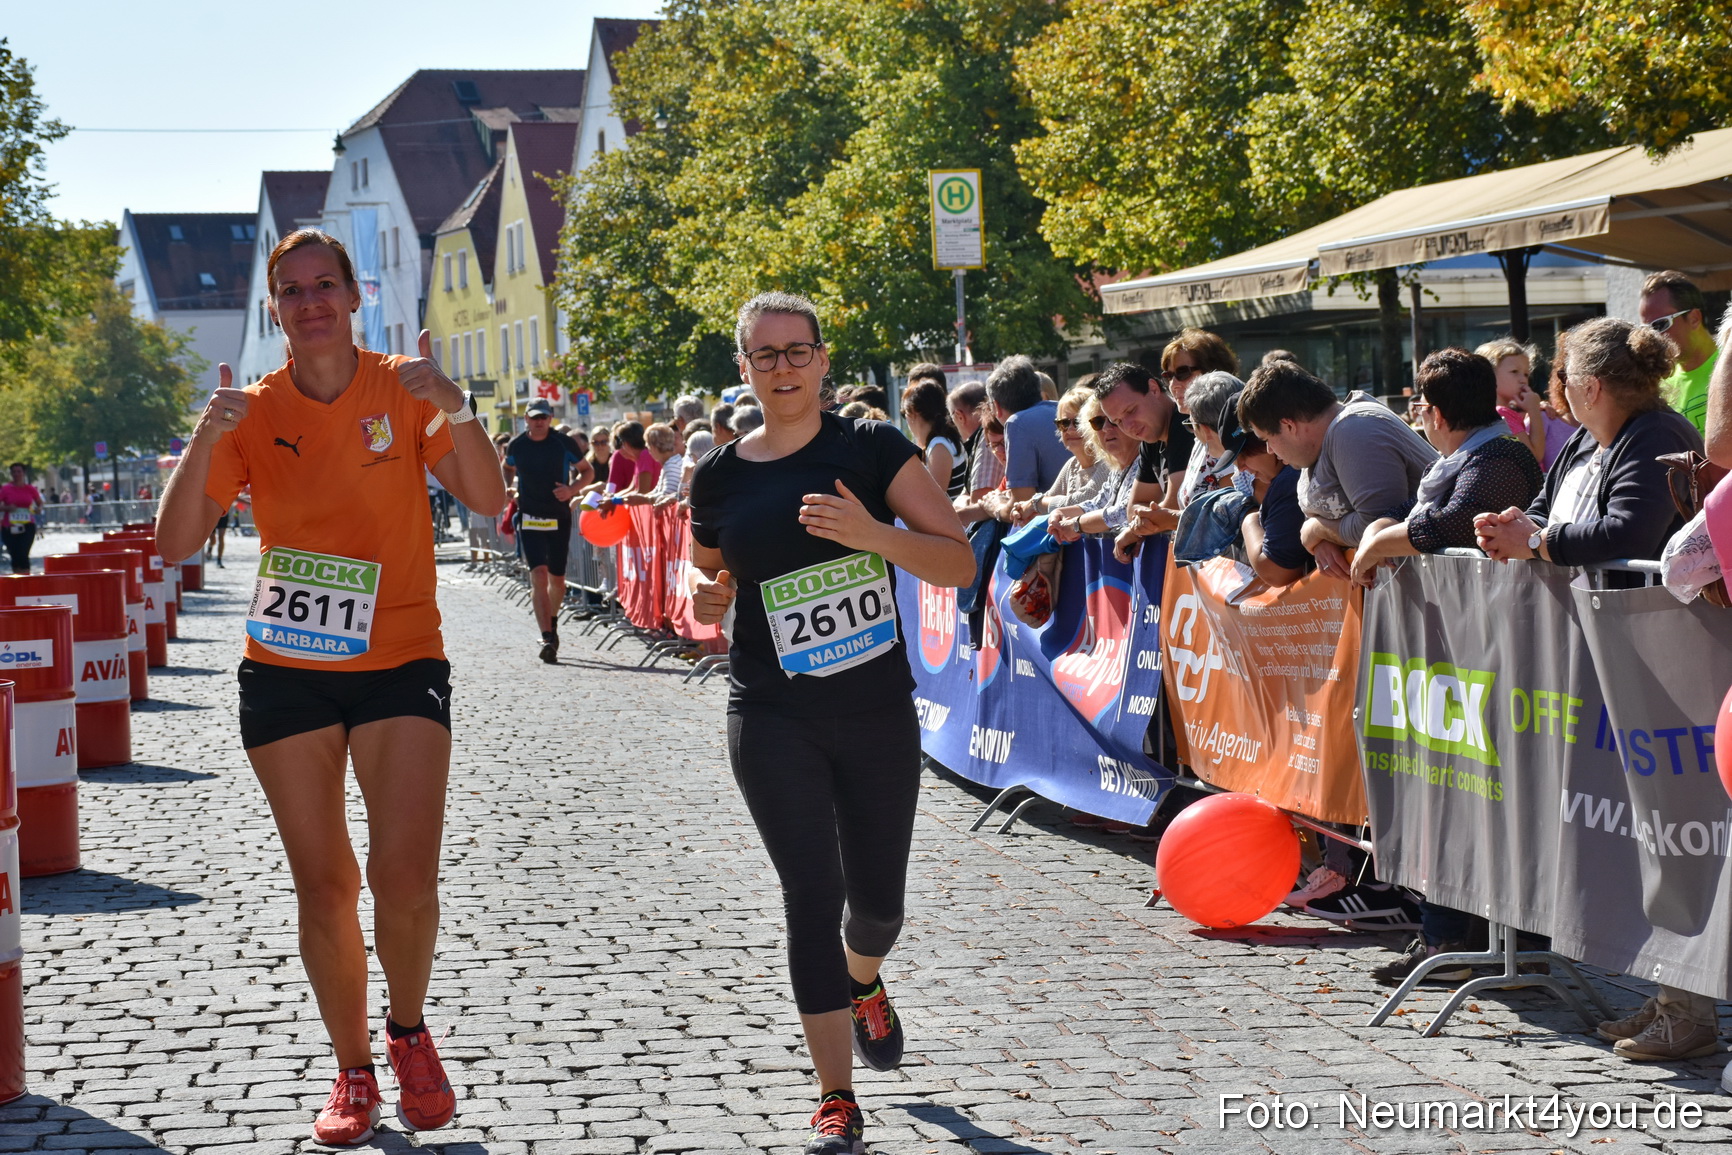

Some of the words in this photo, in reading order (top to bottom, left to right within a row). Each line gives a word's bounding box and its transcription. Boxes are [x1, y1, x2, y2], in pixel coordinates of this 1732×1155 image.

[268, 552, 364, 587] BOCK
[773, 557, 874, 605] BOCK
[262, 585, 355, 631] 2611
[784, 589, 881, 646] 2610
[1143, 605, 1160, 624] STO
[1270, 601, 1311, 617] moderner
[1310, 596, 1343, 613] Partner
[262, 627, 350, 654] BARBARA
[1248, 621, 1259, 637] die
[1258, 622, 1301, 640] Konzeption
[1301, 618, 1319, 634] und
[808, 631, 875, 667] NADINE
[1137, 649, 1163, 671] ONLI
[1256, 642, 1275, 656] Ihrer
[1273, 642, 1308, 660] Projekte
[1308, 647, 1322, 656] was
[1015, 657, 1036, 678] MOBILE
[1370, 664, 1488, 752] BOCK
[1098, 755, 1121, 793] GET
